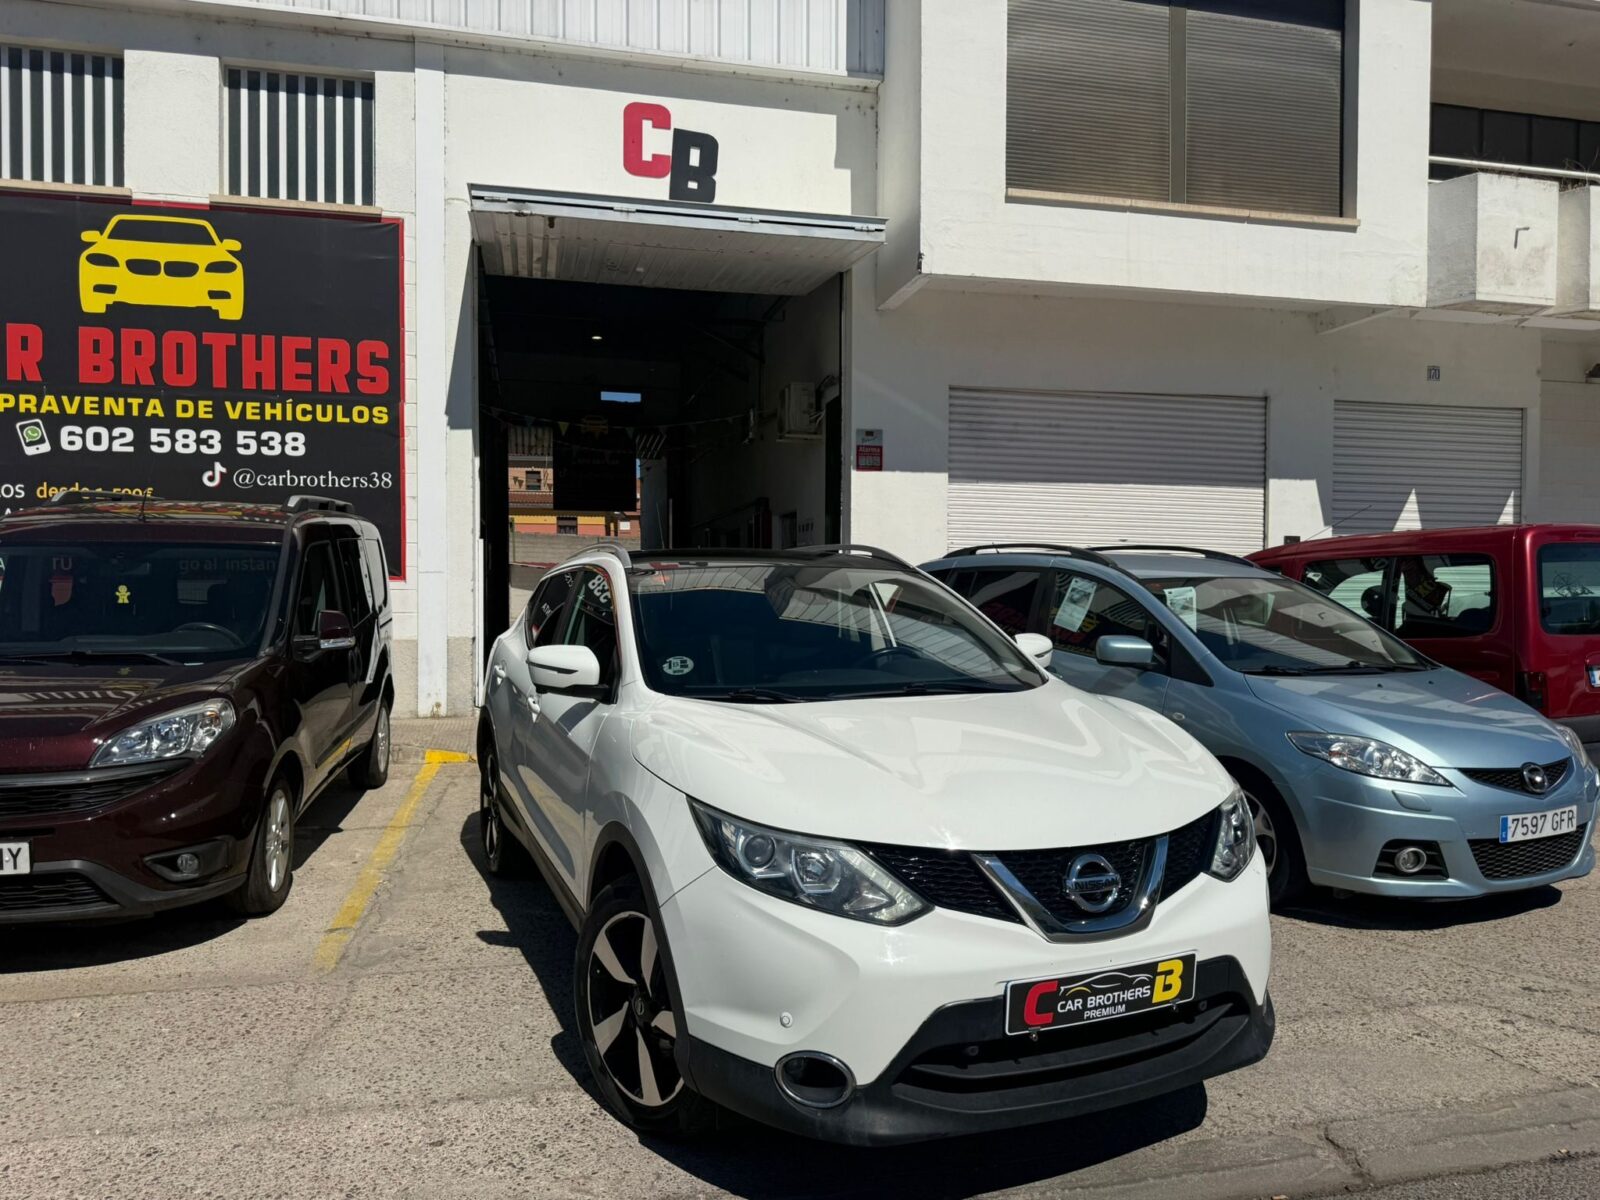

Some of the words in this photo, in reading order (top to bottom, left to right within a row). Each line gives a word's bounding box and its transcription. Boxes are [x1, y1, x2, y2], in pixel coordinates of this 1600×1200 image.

[78, 325, 390, 395] BROTHERS
[176, 399, 214, 420] DE
[225, 398, 389, 425] VEHÍCULOS
[60, 425, 135, 454] 602
[149, 428, 222, 455] 583
[236, 430, 306, 457] 538
[0, 484, 25, 498] OS
[233, 467, 393, 490] @carbrothers38
[1511, 815, 1547, 838] 7597
[1551, 809, 1574, 832] GFR
[0, 847, 22, 871] Y
[1074, 876, 1119, 890] NISSAN
[1024, 980, 1059, 1026] C
[1057, 998, 1083, 1013] CAR
[1087, 986, 1151, 1008] BROTHERS
[1084, 1004, 1126, 1020] PREMIUM
